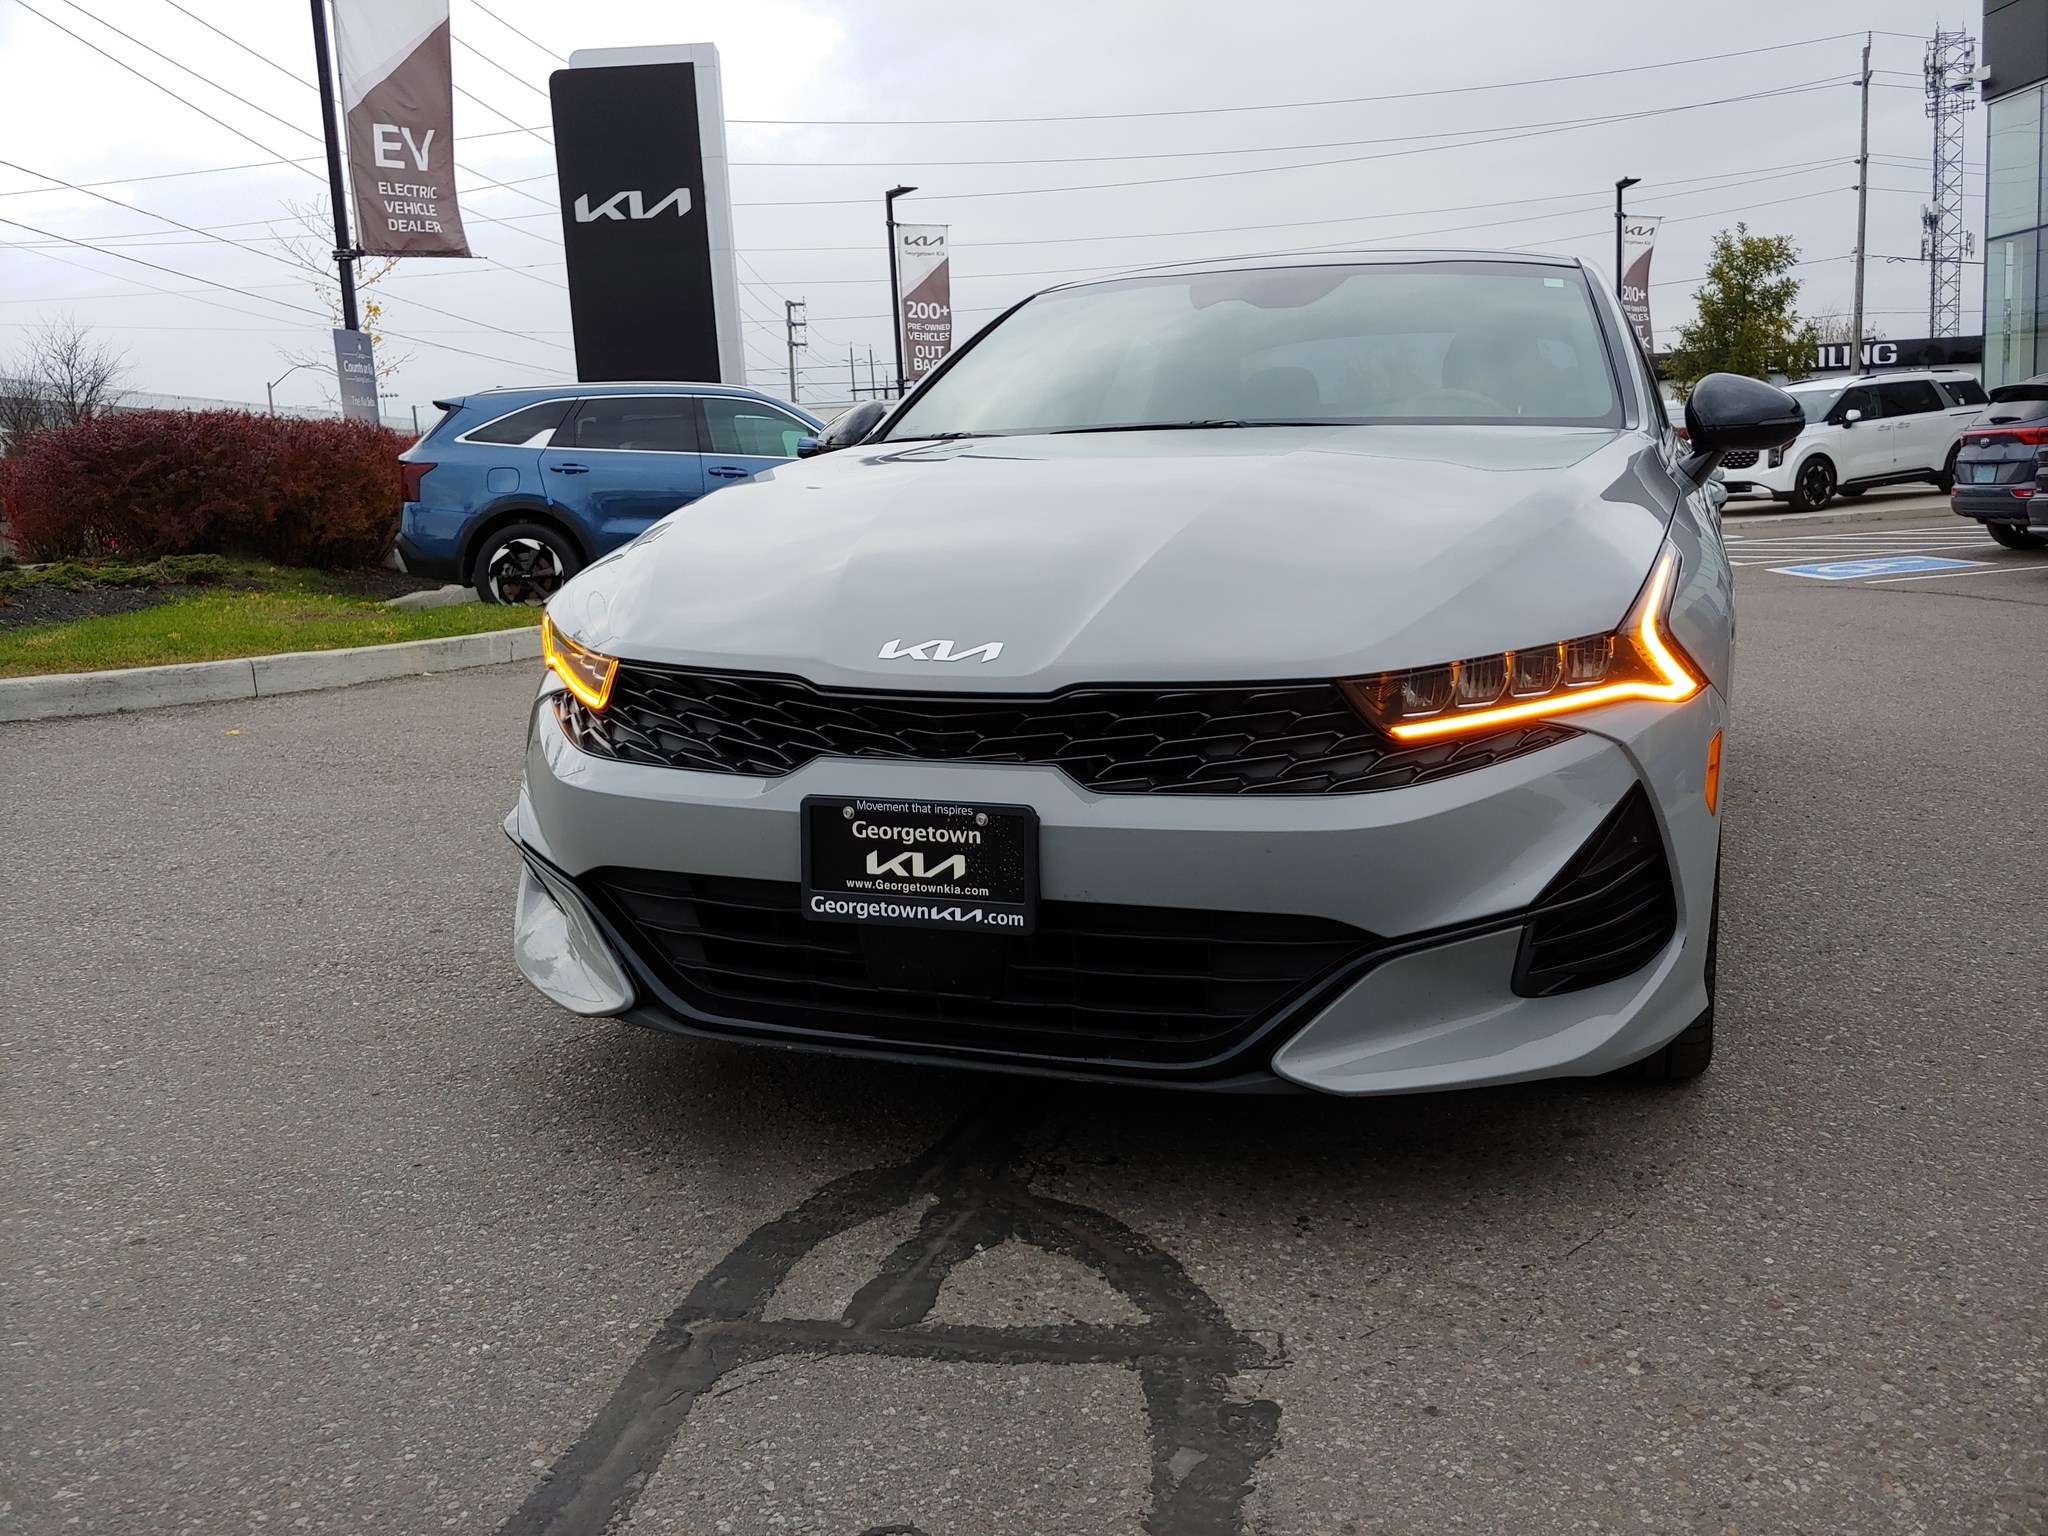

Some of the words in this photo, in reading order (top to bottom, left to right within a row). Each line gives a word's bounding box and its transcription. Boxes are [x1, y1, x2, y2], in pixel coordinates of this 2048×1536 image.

[372, 123, 435, 171] EV
[378, 181, 438, 199] ELECTRIC
[384, 200, 438, 217] VEHICLE
[574, 187, 692, 223] KIA
[388, 218, 443, 234] DEALER
[1624, 225, 1655, 237] KIA
[904, 235, 944, 247] KIA
[906, 301, 950, 320] 200+
[907, 322, 951, 331] PRE-OWNED
[907, 331, 951, 342] VEHICLES
[915, 344, 945, 359] OUT
[878, 638, 1004, 663] KIA
[856, 800, 909, 813] Movement
[911, 803, 931, 814] that
[934, 803, 974, 817] inspires
[851, 820, 981, 845] Georgetown
[866, 849, 966, 880] KIA
[846, 879, 989, 897] www.Georgetownkia.com
